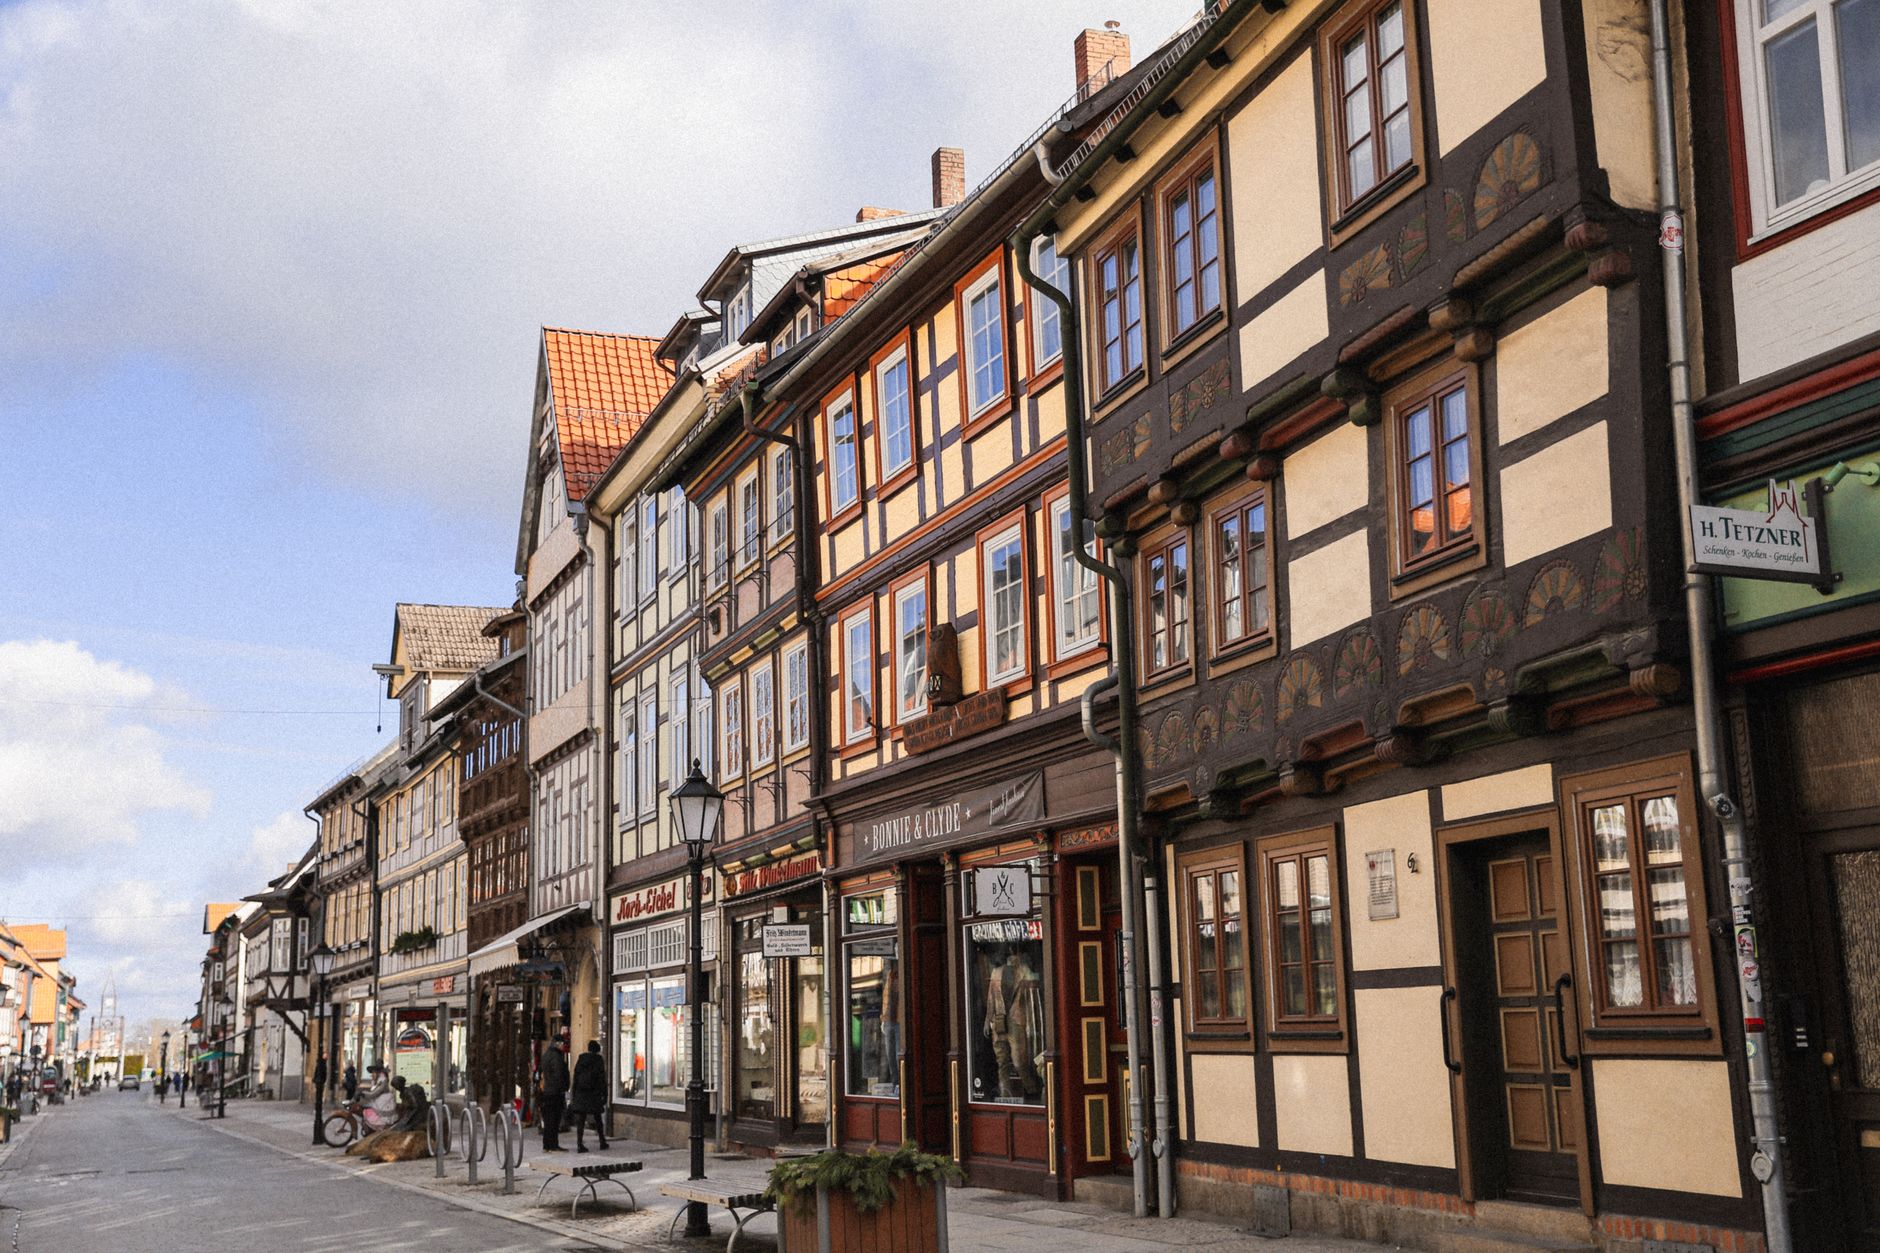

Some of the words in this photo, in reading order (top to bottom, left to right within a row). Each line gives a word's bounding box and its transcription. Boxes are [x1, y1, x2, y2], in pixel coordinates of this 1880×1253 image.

[1700, 520, 1718, 538] H.
[1719, 517, 1801, 547] TETZNER
[1703, 545, 1735, 557] Schenken
[1742, 548, 1767, 559] Kochen
[1773, 552, 1804, 564] Genießen
[873, 816, 911, 851] BONNIE
[914, 815, 922, 839] &
[925, 803, 961, 838] CLYDE
[992, 883, 997, 894] B
[1010, 883, 1014, 894] C
